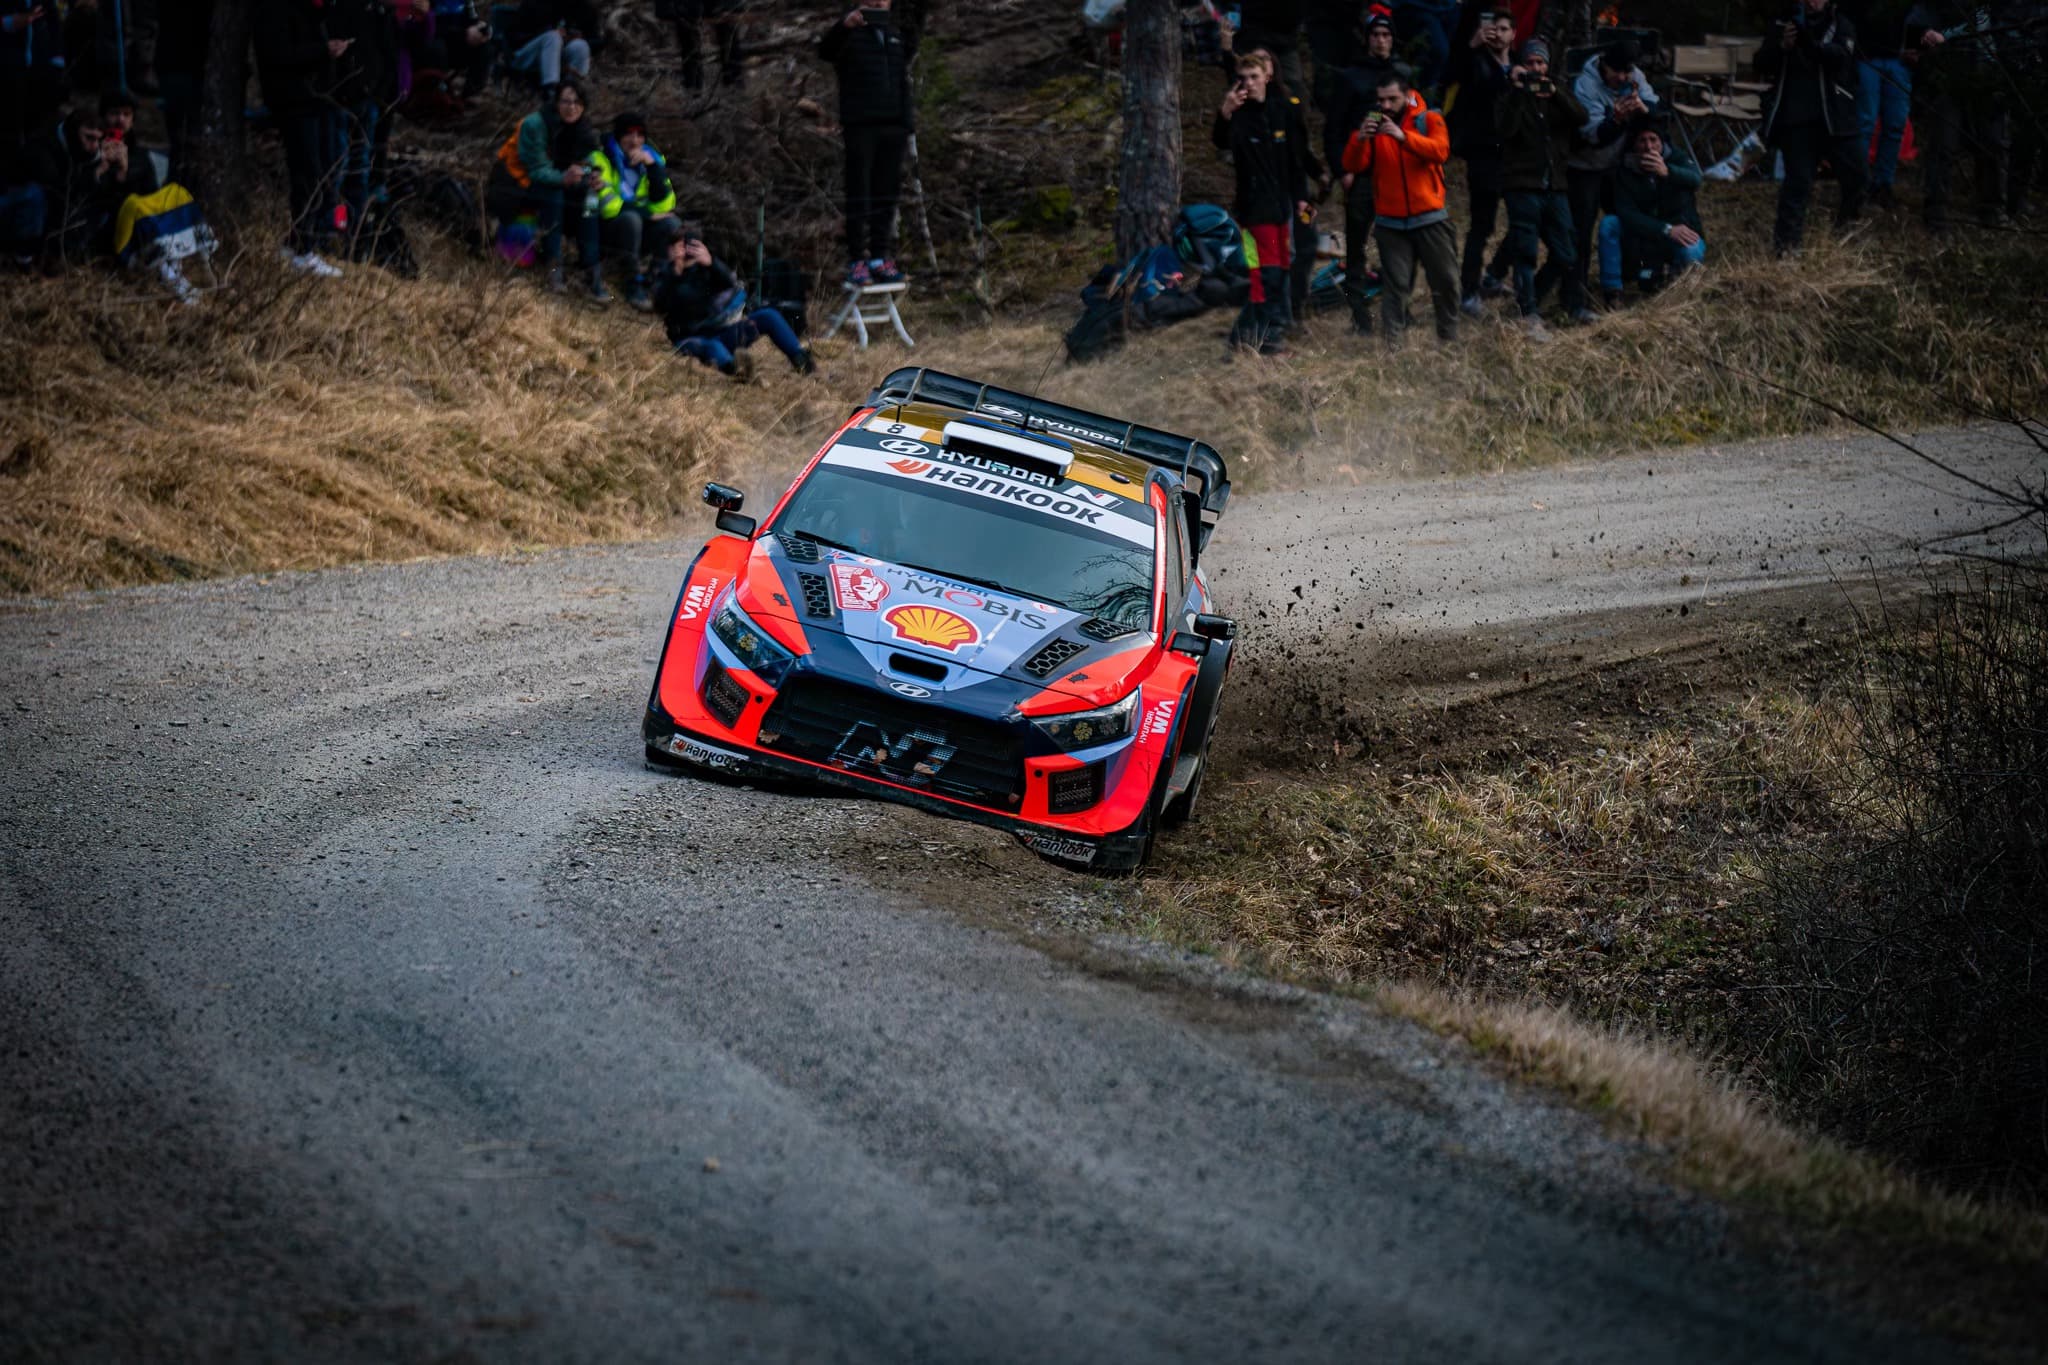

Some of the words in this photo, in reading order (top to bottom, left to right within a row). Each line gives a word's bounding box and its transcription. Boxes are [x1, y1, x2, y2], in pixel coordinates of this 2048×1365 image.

[886, 423, 905, 435] 8
[1028, 415, 1125, 445] HYUNDAI
[936, 449, 1056, 488] HYUNDAI
[887, 567, 989, 598] HYUNDAI
[901, 579, 1047, 630] MOBIS
